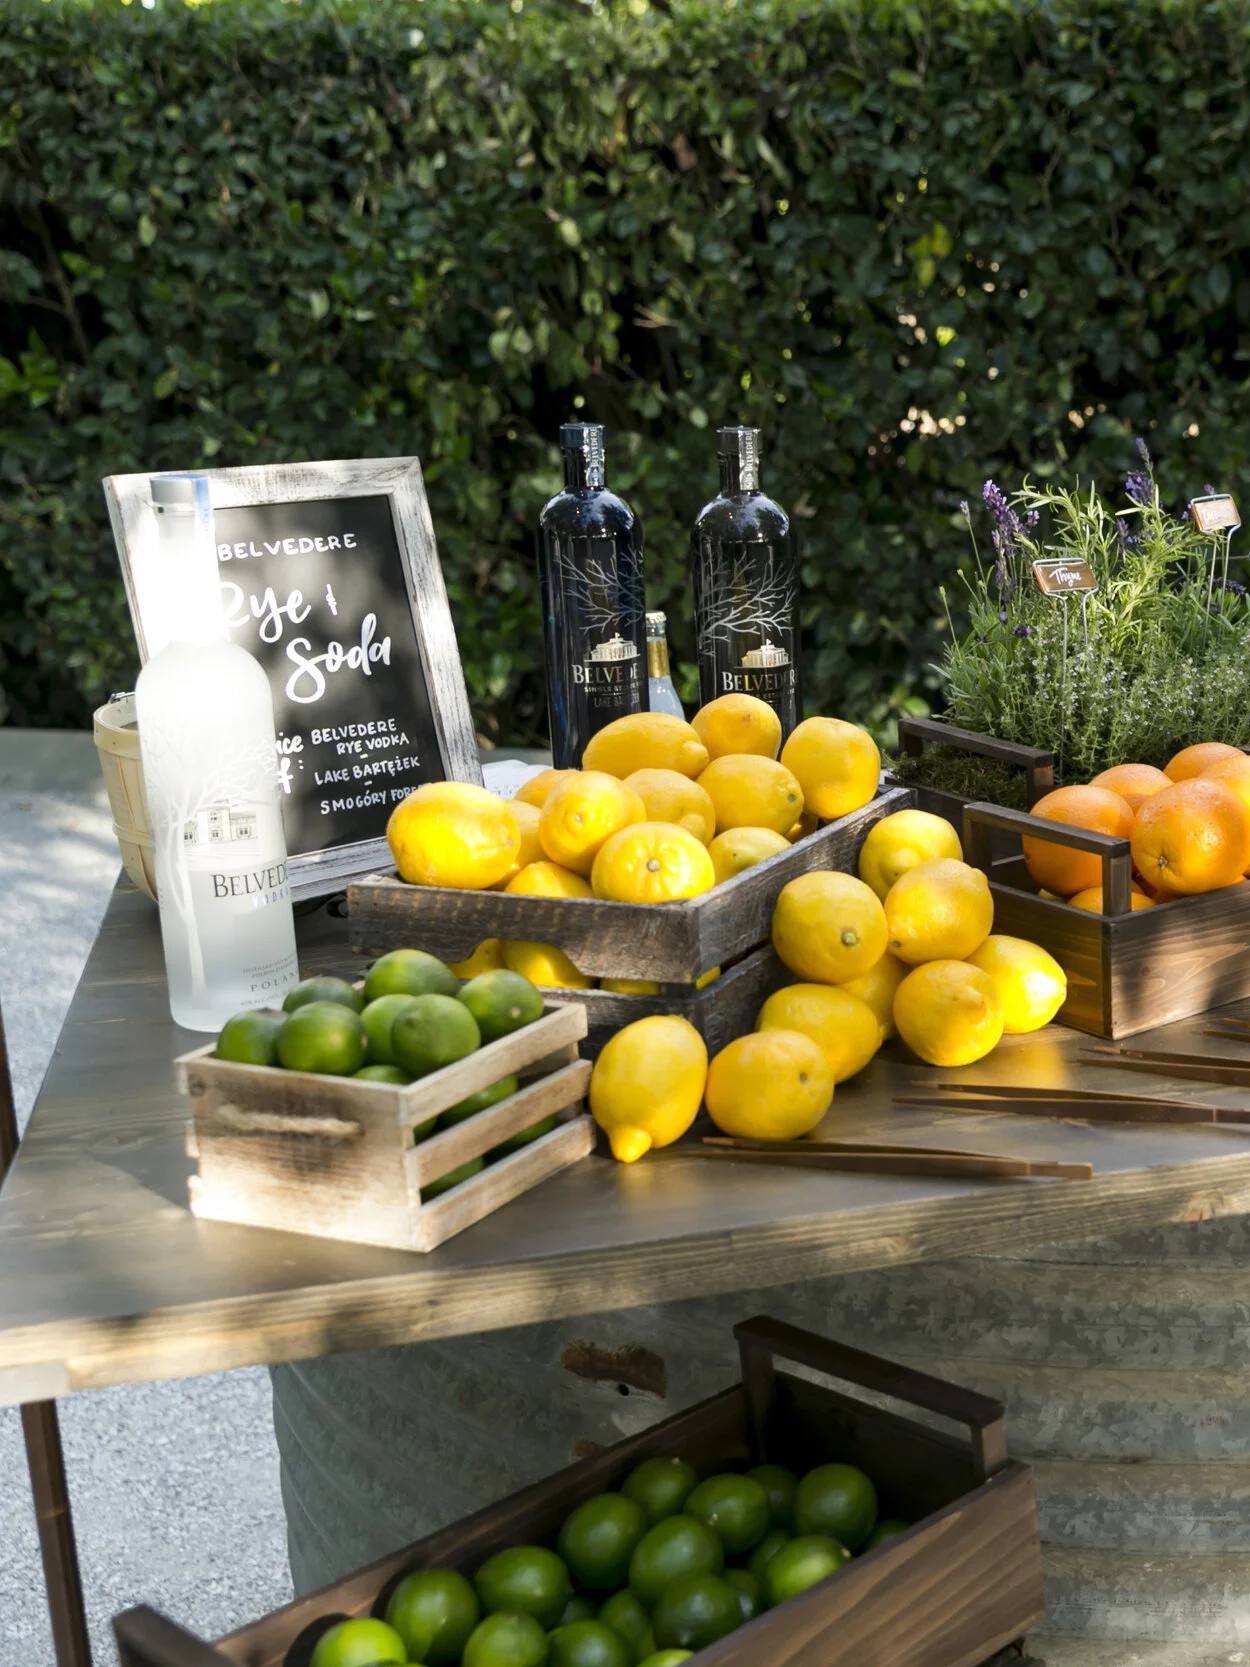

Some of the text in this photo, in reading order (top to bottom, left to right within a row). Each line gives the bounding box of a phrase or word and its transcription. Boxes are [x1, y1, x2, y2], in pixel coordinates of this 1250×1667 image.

[217, 533, 358, 562] BELVEDERE
[1048, 567, 1082, 587] Thyme
[220, 581, 312, 644] Rye
[285, 612, 392, 704] Soda
[275, 731, 304, 754] ice
[311, 718, 397, 745] BELVEDERE
[336, 732, 409, 755] RYE VODKA
[314, 767, 350, 785] LAKE
[320, 783, 431, 814] SMOGÓRY FOR
[209, 860, 289, 898] BELVED
